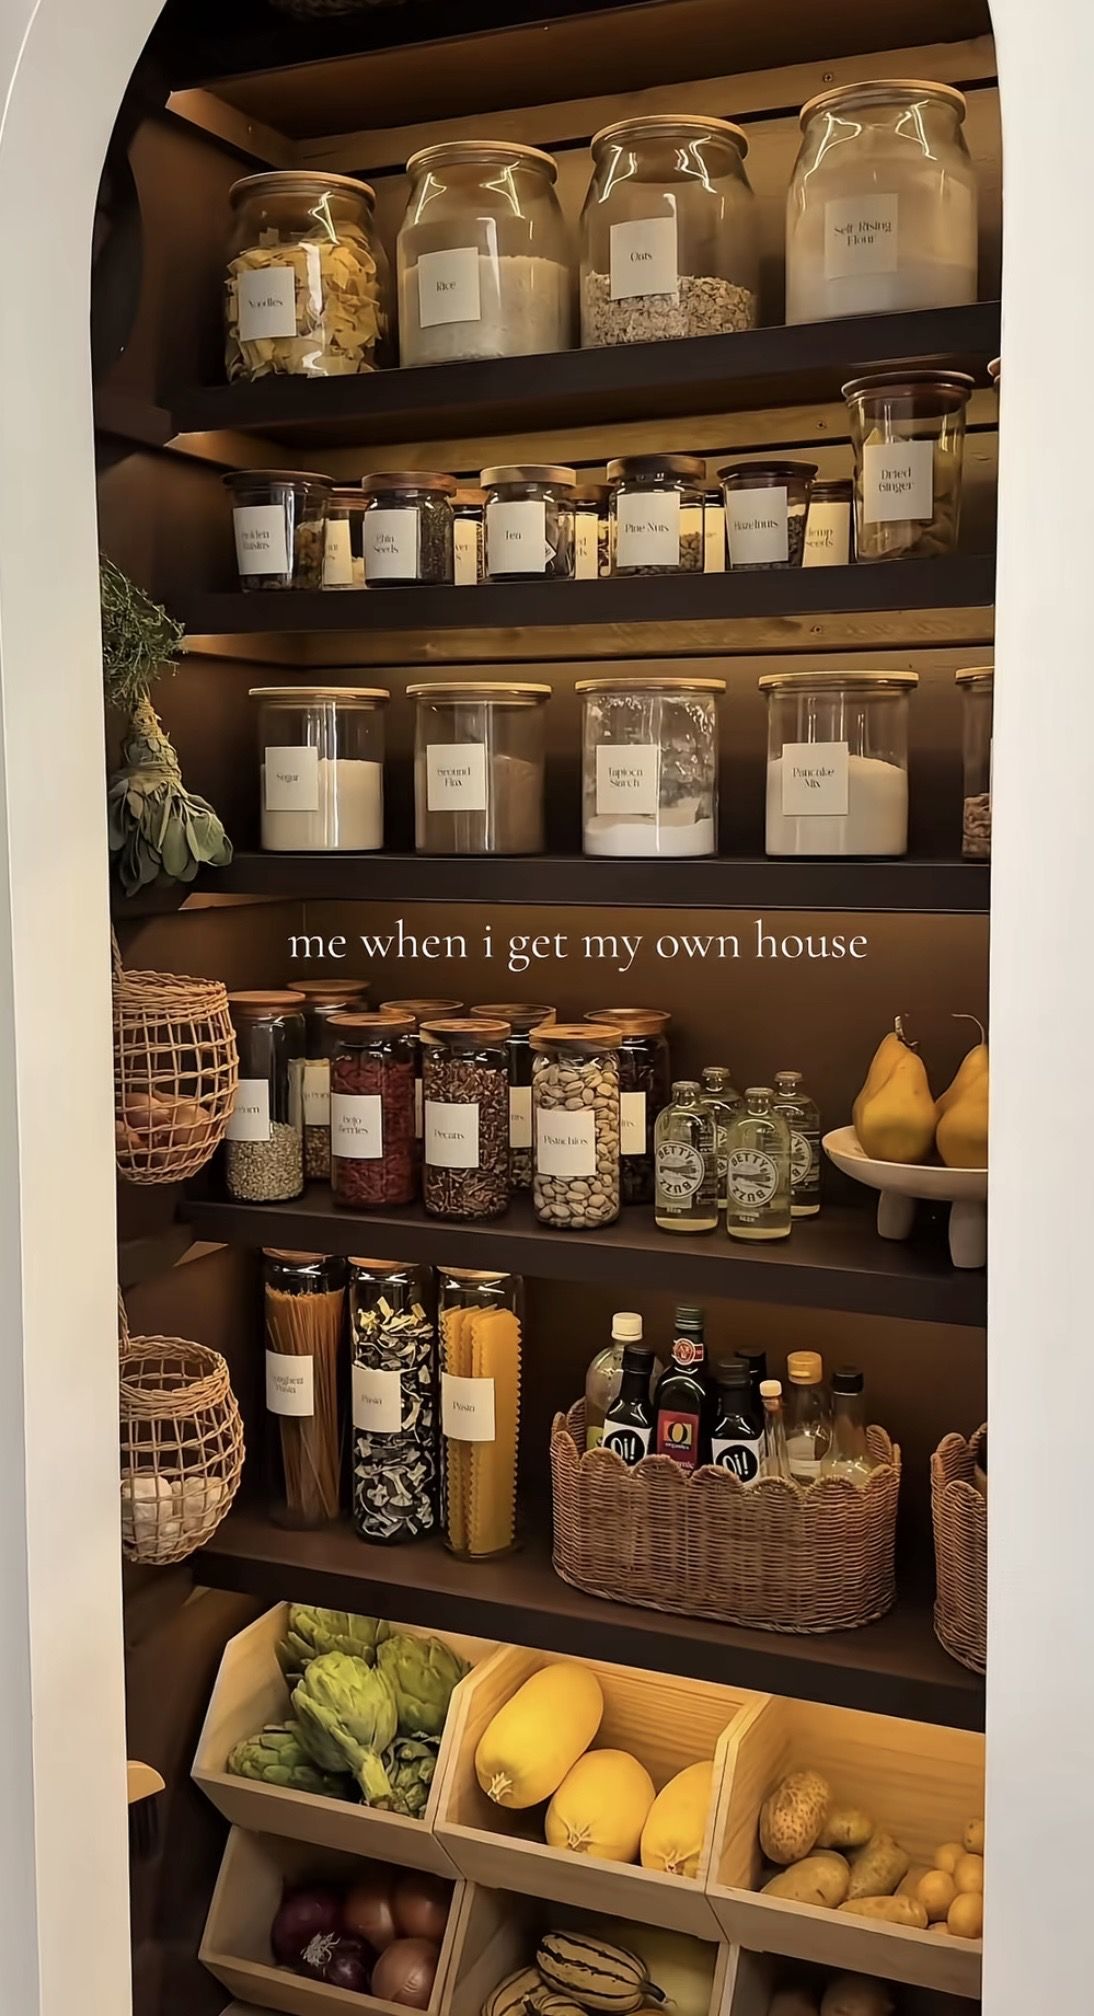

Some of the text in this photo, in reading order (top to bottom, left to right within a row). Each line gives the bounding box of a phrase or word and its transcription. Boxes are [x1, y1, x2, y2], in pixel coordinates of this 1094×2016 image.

[834, 220, 892, 235] Self Rising
[847, 234, 875, 246] Flour
[630, 251, 653, 262] Oats
[436, 281, 456, 292] Rice
[249, 297, 283, 308] Noodles
[881, 466, 912, 480] Dried
[879, 482, 914, 494] Ginger
[625, 522, 670, 534] Pine Nuts
[733, 519, 778, 531] Hazelnuts
[505, 530, 521, 541] Tea
[374, 544, 399, 554] Seeds
[276, 773, 299, 783] Sugar
[437, 767, 471, 777] Ground
[609, 767, 643, 779] Tapioca
[793, 767, 835, 778] Pancake
[444, 777, 462, 787] Flax
[610, 778, 640, 788] Starch
[805, 778, 821, 788] Mix
[434, 1129, 465, 1140] Pecans
[544, 1135, 589, 1146] Pistachios
[658, 1145, 694, 1160] BETTY
[731, 1153, 768, 1167] BETTY
[659, 1178, 692, 1194] BUZZ
[732, 1186, 766, 1202] BUZZ
[452, 1401, 476, 1413] Pasta
[610, 1437, 636, 1460] Oi!
[722, 1450, 749, 1475] Oi!
